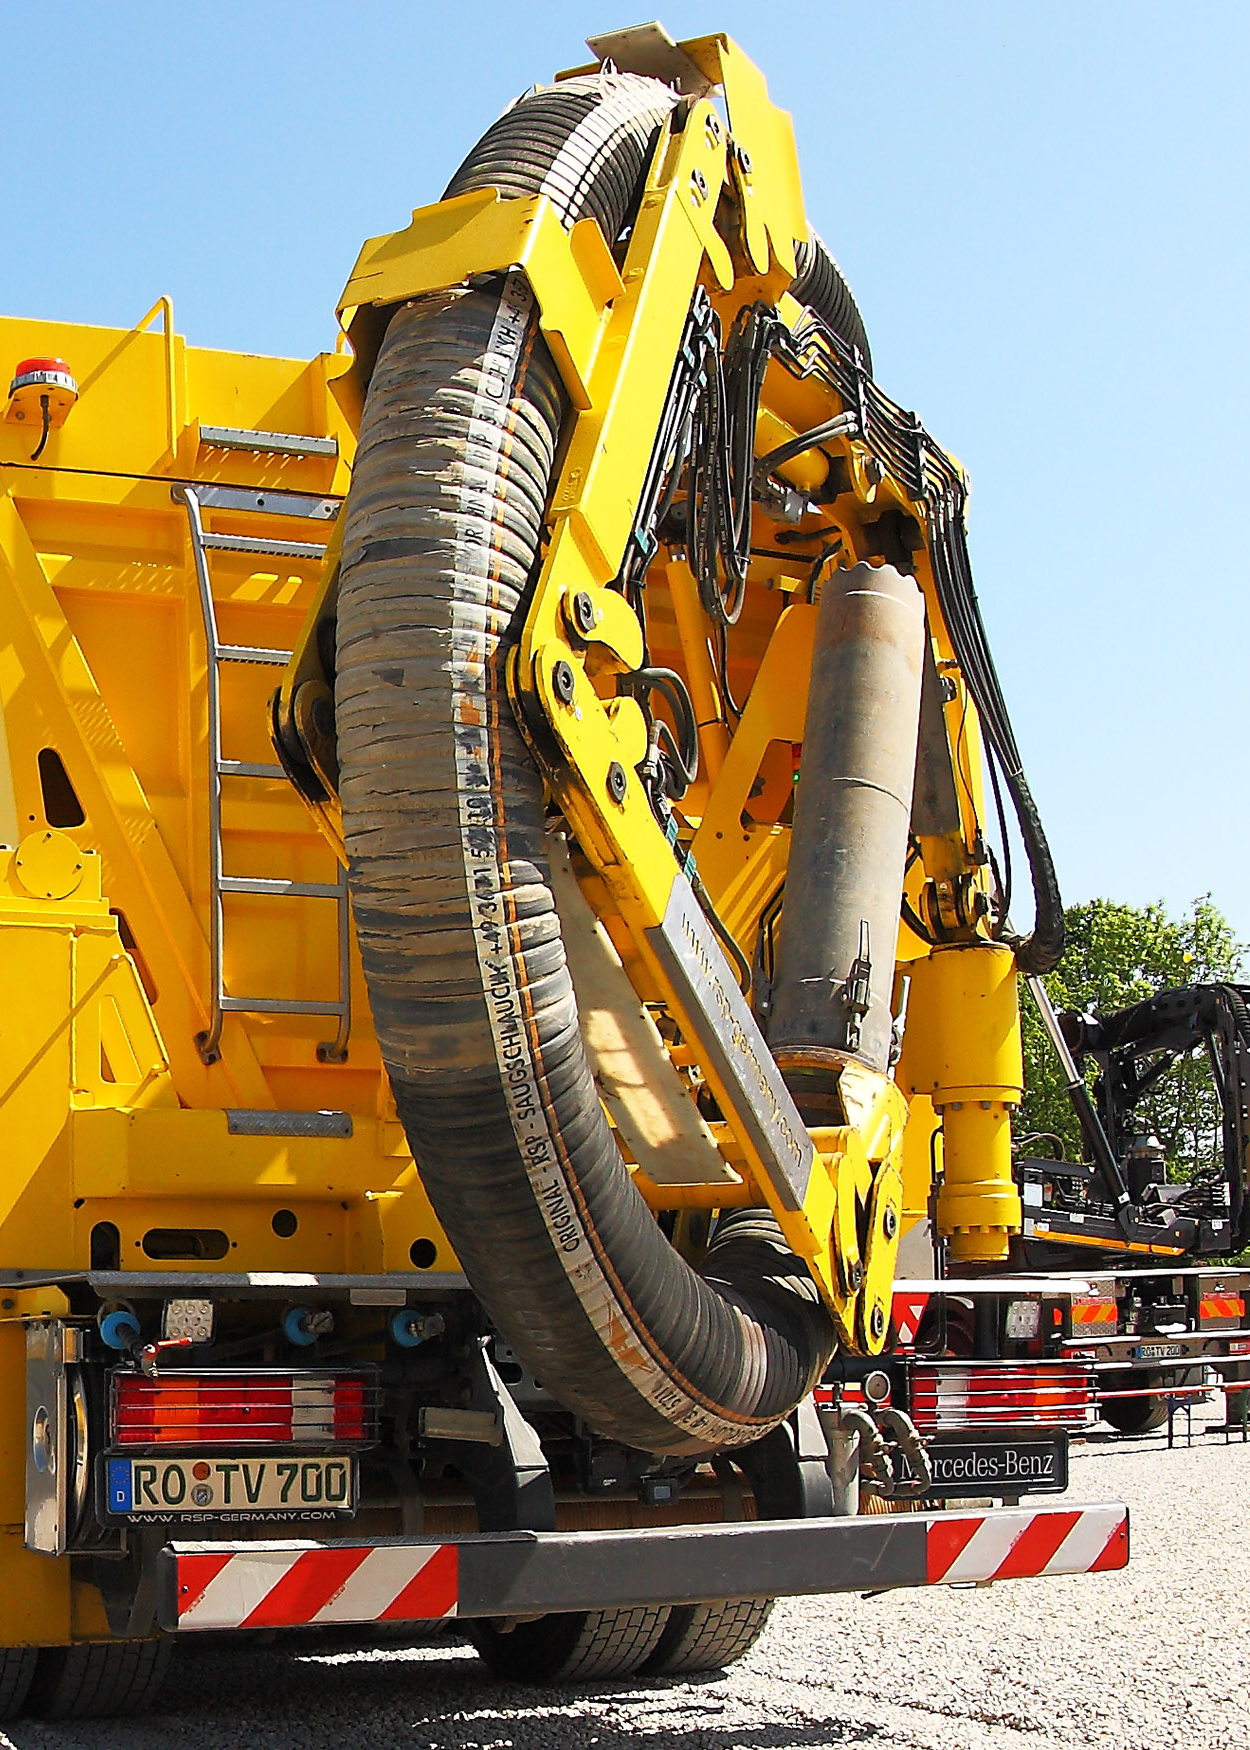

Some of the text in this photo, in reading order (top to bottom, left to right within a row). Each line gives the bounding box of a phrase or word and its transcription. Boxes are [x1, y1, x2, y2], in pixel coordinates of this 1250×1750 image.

[541, 1179, 580, 1253] ORIGINAL
[116, 1462, 347, 1506] D RO TV 700
[901, 1451, 1054, 1480] Mrcedes-Benz
